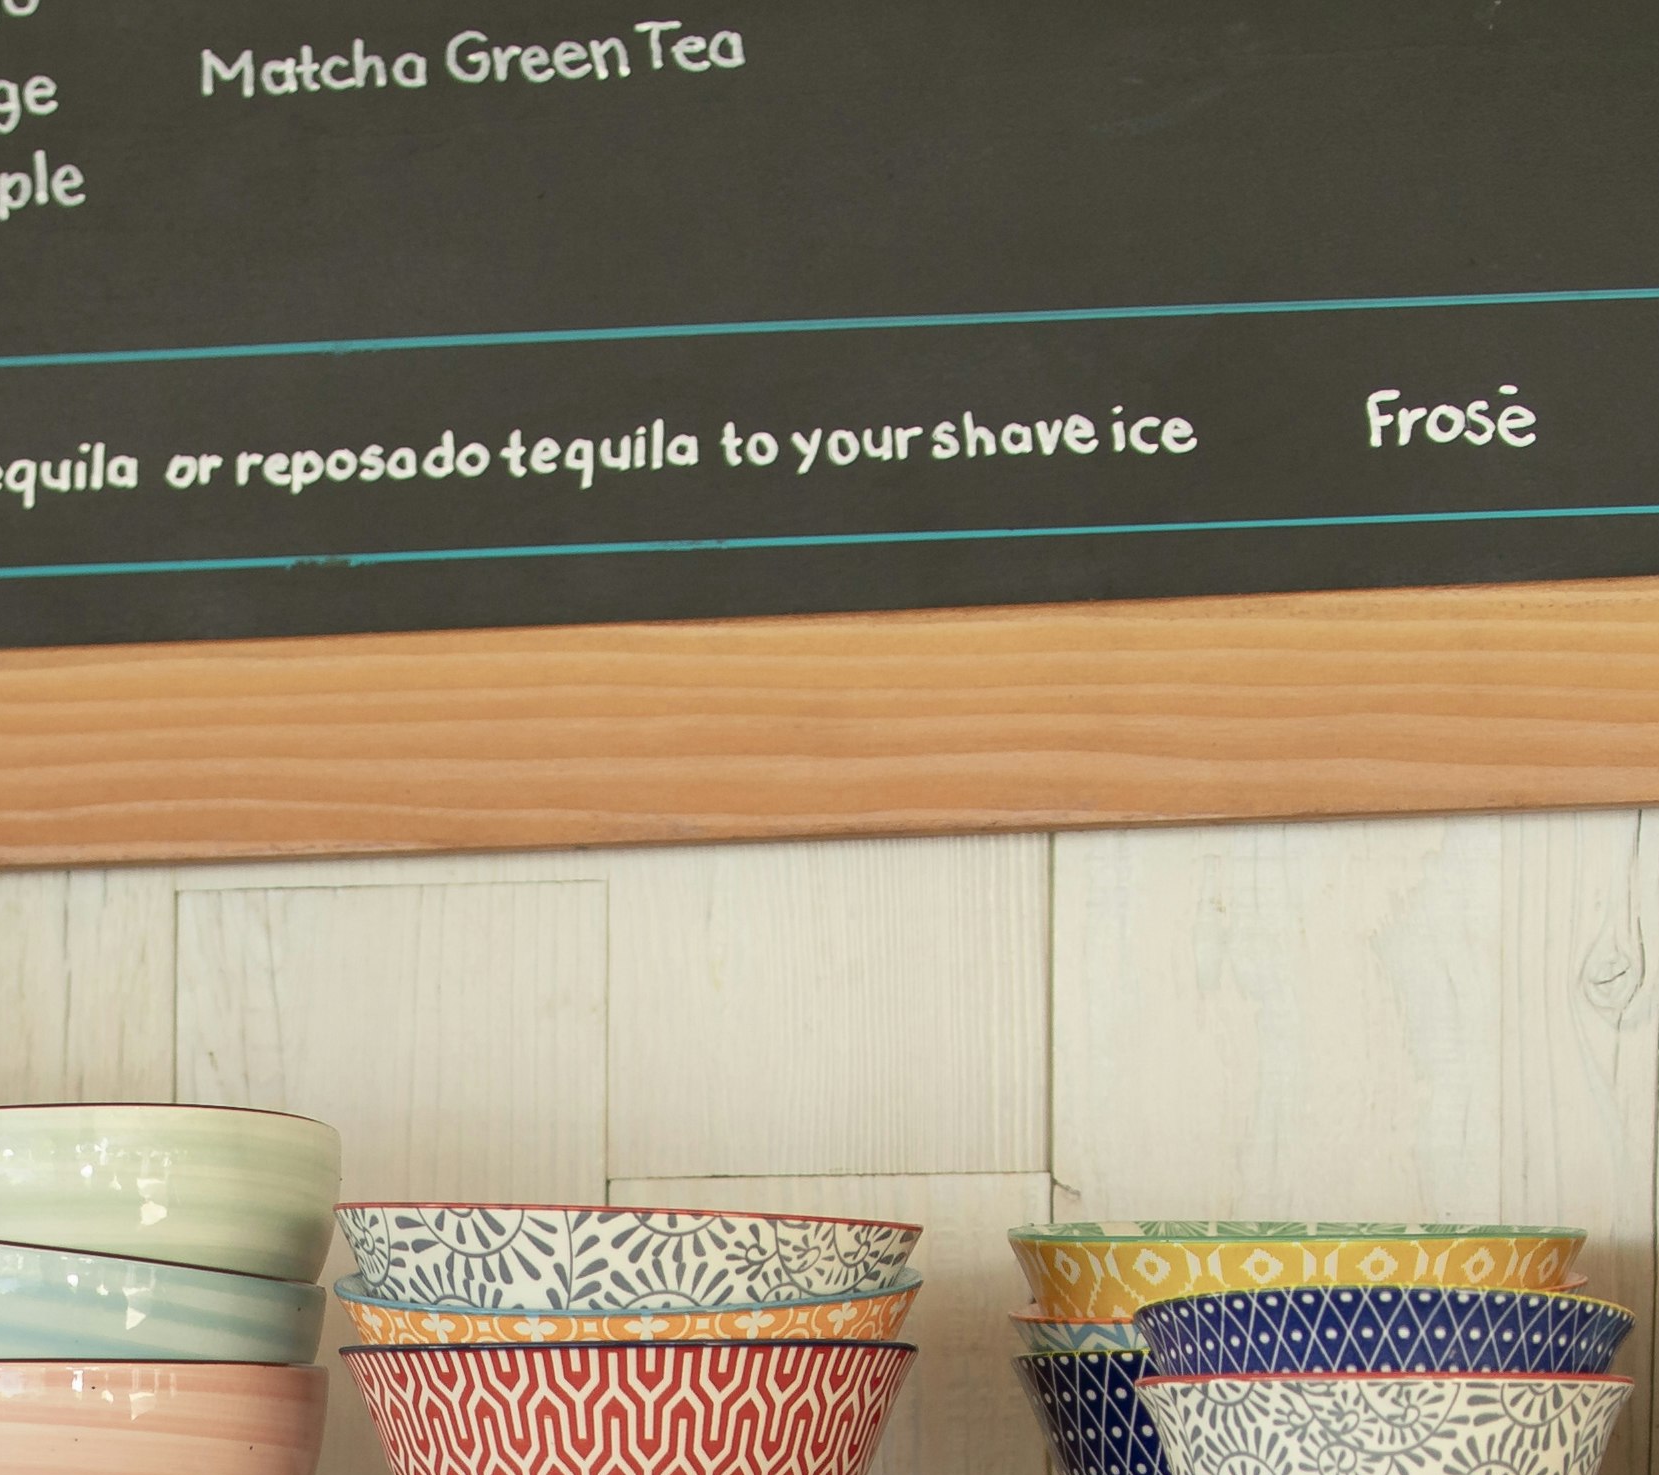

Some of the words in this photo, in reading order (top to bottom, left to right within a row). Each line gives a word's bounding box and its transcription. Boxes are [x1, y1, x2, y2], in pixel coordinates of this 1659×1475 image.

[199, 28, 429, 100] Matcha
[444, 28, 633, 85] Green
[632, 18, 748, 72] Tea
[163, 451, 226, 491] or
[234, 439, 493, 497] reposado
[497, 425, 701, 492] tequila
[718, 418, 782, 470] to
[788, 423, 931, 478] your
[928, 406, 1101, 462] shave
[1109, 403, 1201, 457] ice
